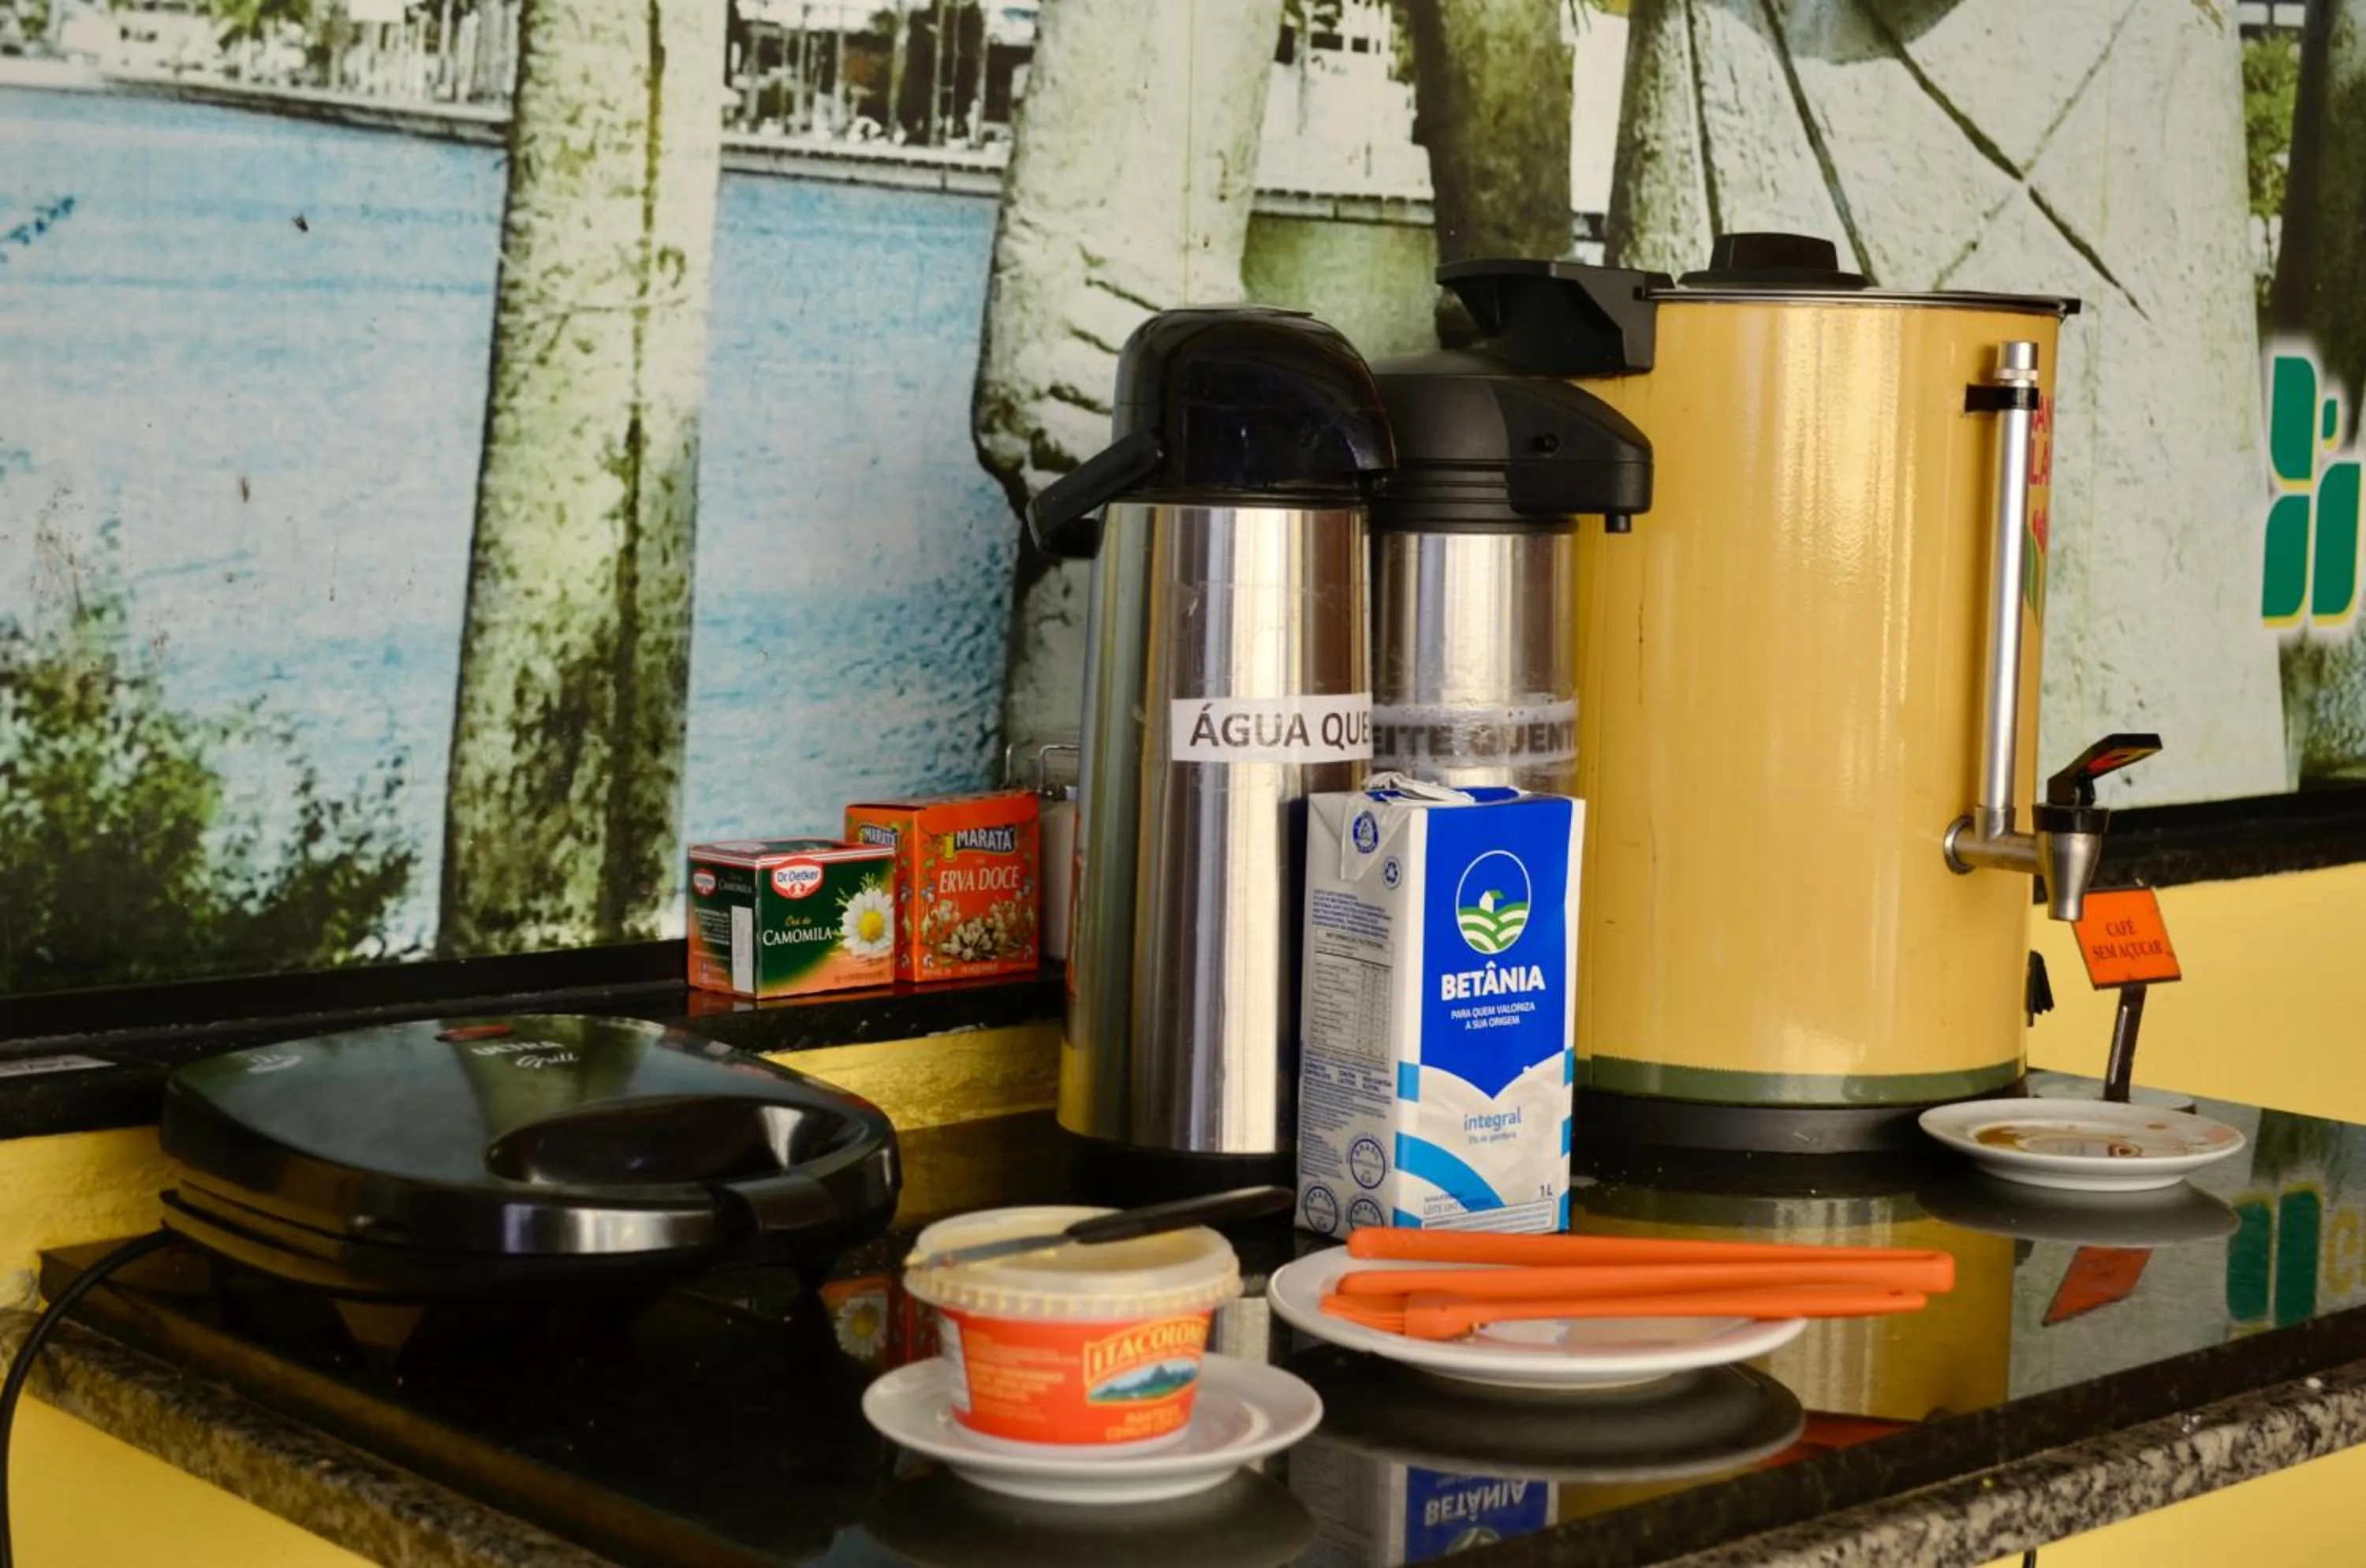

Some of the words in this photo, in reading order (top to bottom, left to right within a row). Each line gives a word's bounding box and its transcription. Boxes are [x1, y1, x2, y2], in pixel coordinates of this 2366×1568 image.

[1189, 702, 1311, 748] ÁGUA
[1373, 724, 1454, 755] EITE
[1469, 721, 1576, 756] QUENT
[939, 870, 975, 894] ERVA
[978, 865, 1020, 890] DOCE
[2105, 917, 2136, 937] CAFÉ
[2092, 943, 2117, 960] SEM
[1441, 960, 1546, 1001] BETÂNIA
[1450, 1009, 1471, 1021] PARA
[1472, 1006, 1495, 1019] QUEM
[1497, 1002, 1536, 1015] VALORIZA
[1465, 1019, 1472, 1031] A
[1472, 1017, 1488, 1029] SUA
[1488, 1014, 1520, 1028] ORIGEM
[1464, 1104, 1521, 1133] integral
